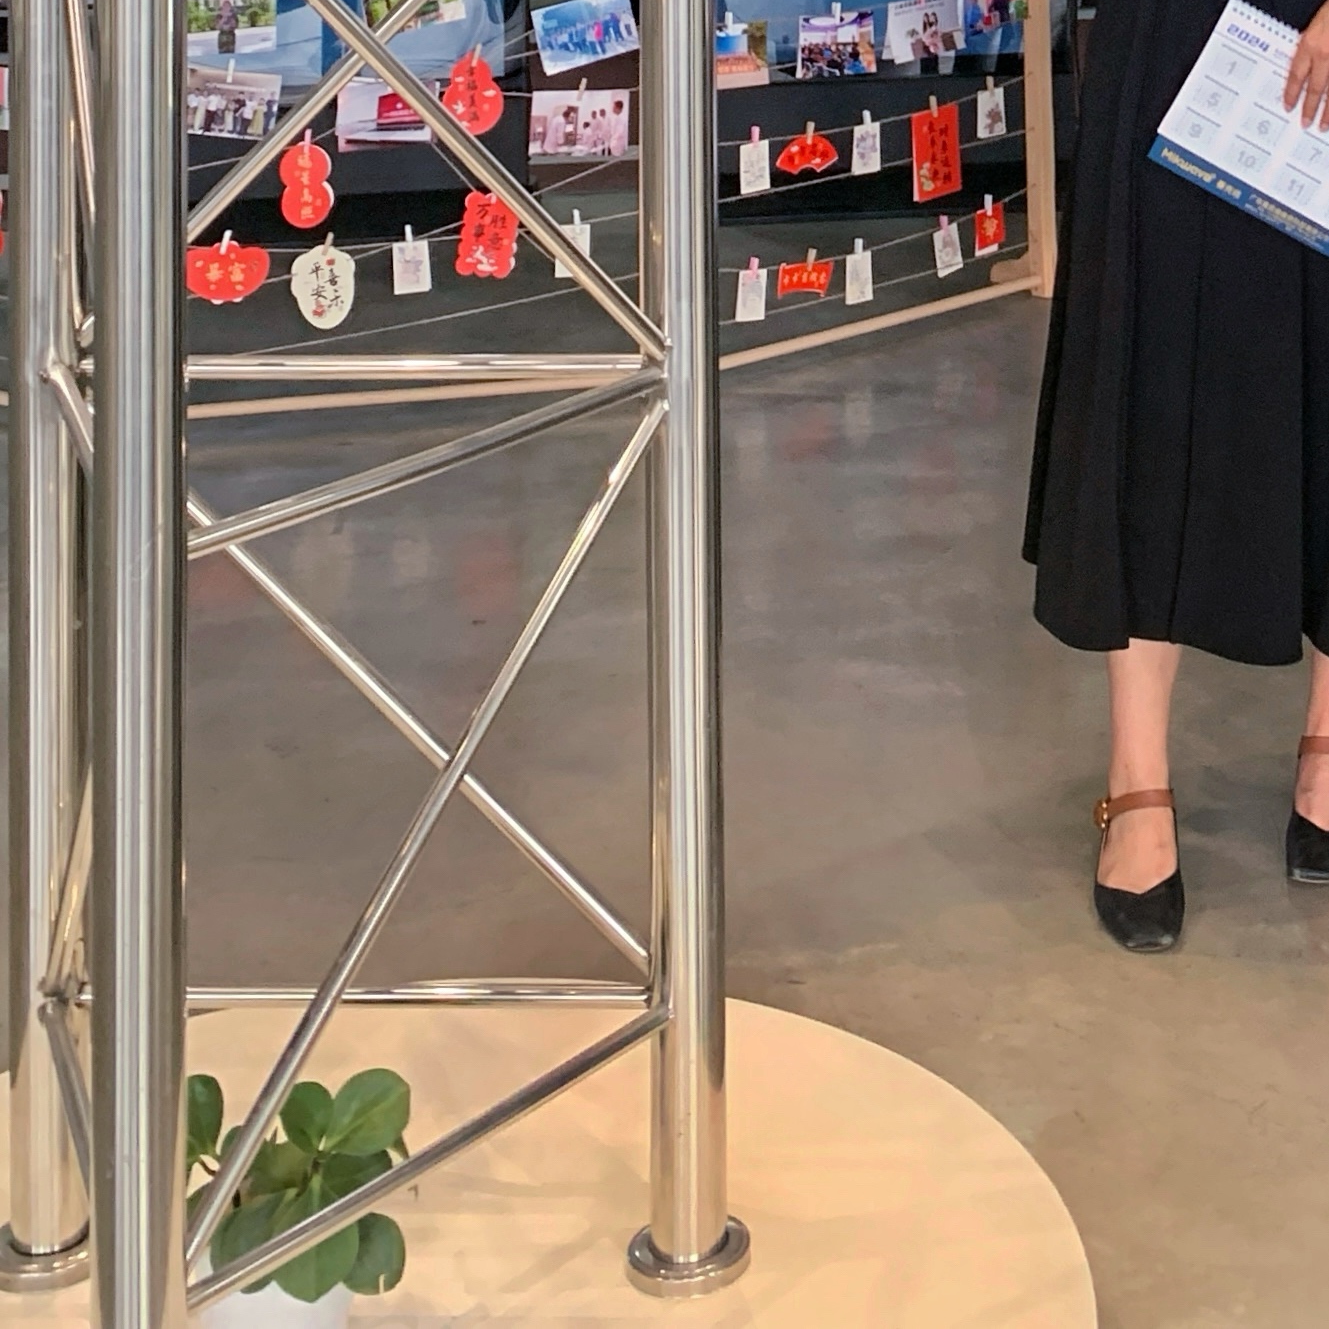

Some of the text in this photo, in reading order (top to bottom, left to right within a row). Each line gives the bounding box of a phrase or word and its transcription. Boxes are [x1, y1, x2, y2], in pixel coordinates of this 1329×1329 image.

[1227, 23, 1269, 53] 2024
[473, 202, 491, 242] 万事
[309, 261, 328, 300] 平安
